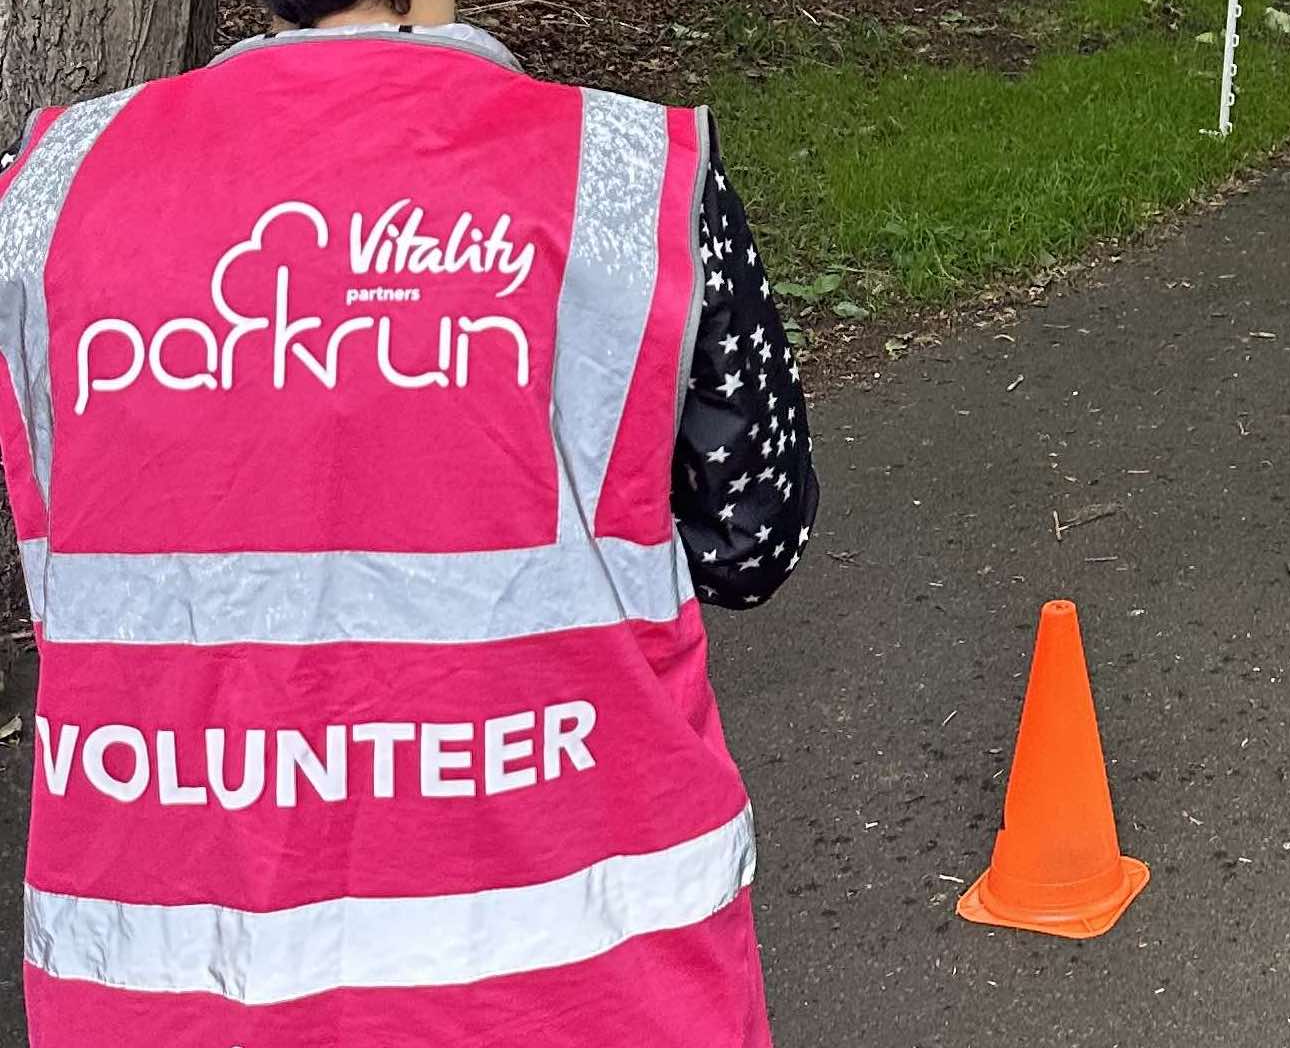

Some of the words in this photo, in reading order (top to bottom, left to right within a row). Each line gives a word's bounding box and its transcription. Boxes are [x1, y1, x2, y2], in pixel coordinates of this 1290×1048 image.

[346, 286, 420, 306] partners
[350, 198, 535, 298] Vitality
[75, 265, 529, 415] parkrun
[37, 700, 597, 810] VOLUNTEER
